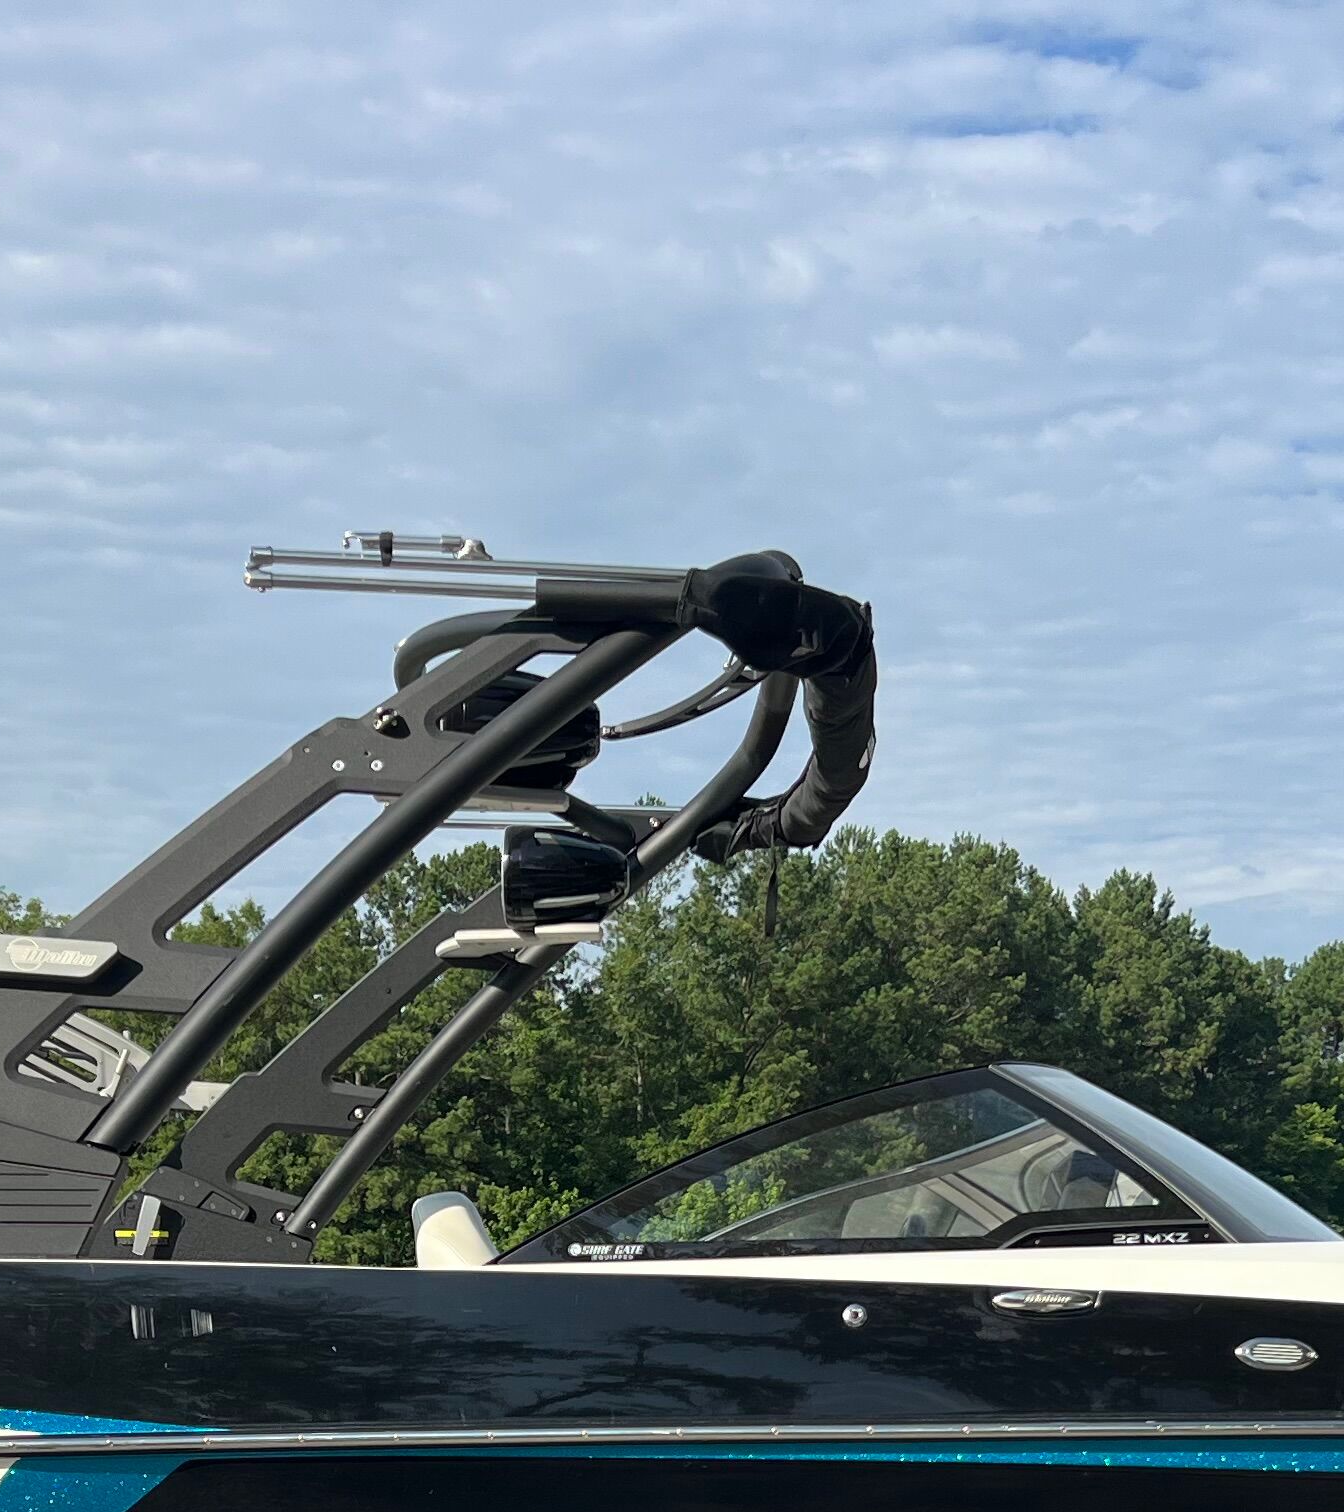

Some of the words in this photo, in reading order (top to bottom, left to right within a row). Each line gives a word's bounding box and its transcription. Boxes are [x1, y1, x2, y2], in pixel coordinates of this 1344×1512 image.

[1112, 1232, 1141, 1245] 22
[1143, 1231, 1191, 1244] MXZ
[580, 1244, 614, 1256] SURF
[614, 1244, 645, 1256] GATE
